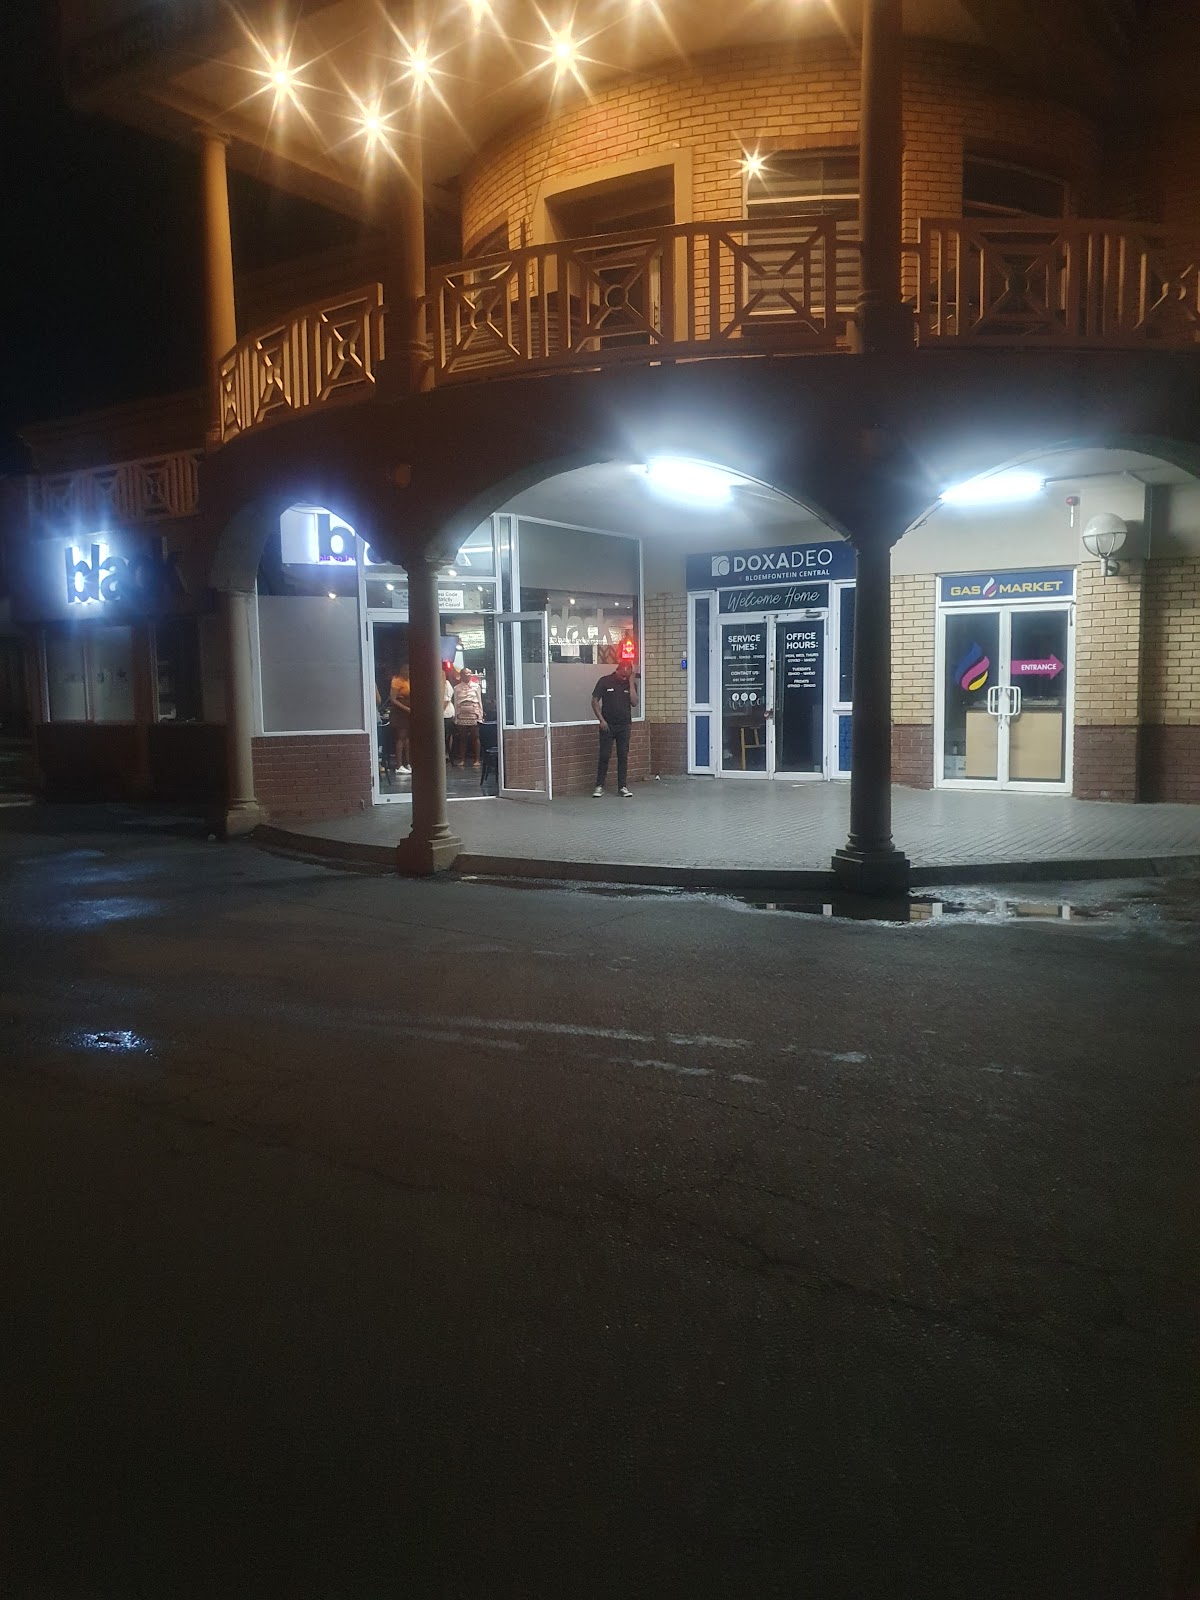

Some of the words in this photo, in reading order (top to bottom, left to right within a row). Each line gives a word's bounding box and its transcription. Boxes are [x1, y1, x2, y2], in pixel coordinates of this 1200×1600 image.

[733, 548, 833, 573] DOXADEO
[745, 572, 797, 582] BLOEMFONTEIN
[799, 569, 830, 578] CENTRAL
[950, 585, 981, 596] GAS
[999, 581, 1063, 594] MARKET
[727, 591, 782, 612] Welcome
[784, 586, 820, 607] Home
[727, 634, 761, 643] SERVICE
[786, 632, 816, 641] OFFICE
[731, 643, 758, 651] TIMES:
[786, 641, 819, 650] HOURS:
[1021, 663, 1057, 671] ENTRANCE
